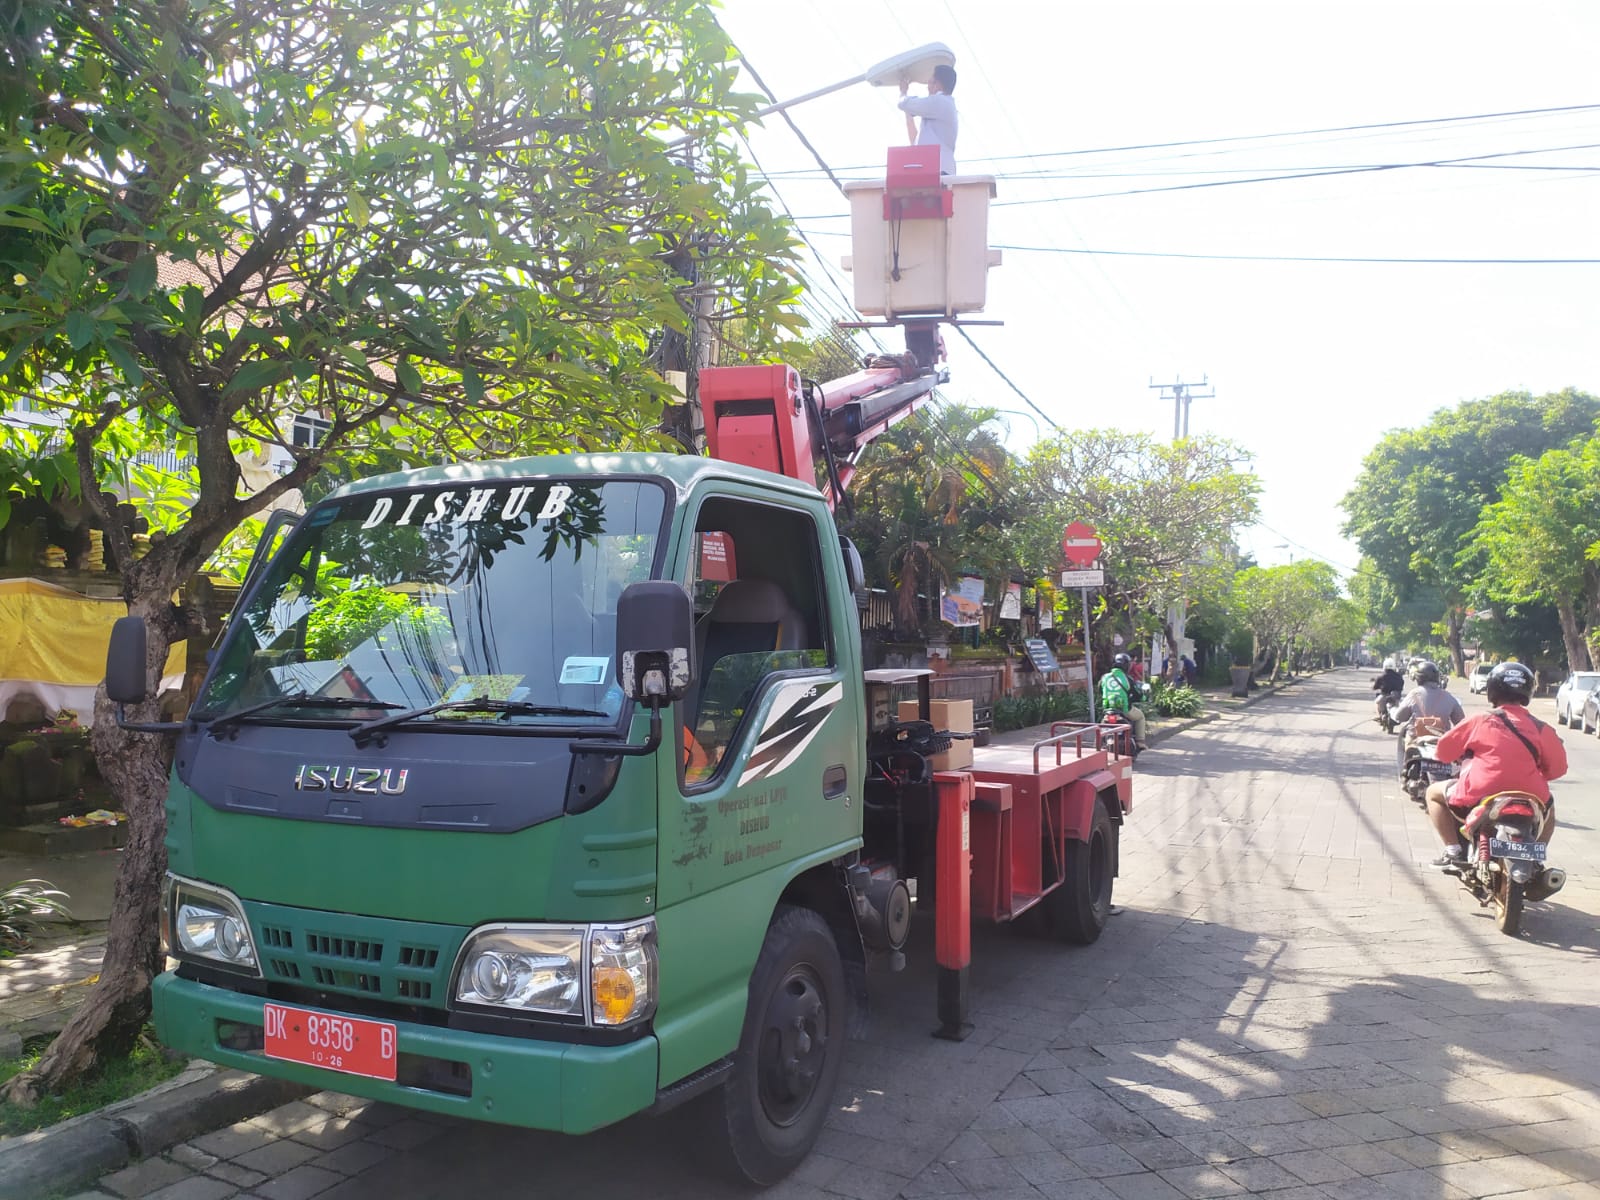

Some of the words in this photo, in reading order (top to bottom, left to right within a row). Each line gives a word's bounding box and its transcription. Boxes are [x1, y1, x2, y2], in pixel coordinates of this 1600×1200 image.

[361, 485, 573, 530] DISHUB
[294, 764, 408, 795] ISUZU
[740, 815, 770, 836] DISHUB
[266, 1007, 287, 1040] DK
[308, 1015, 353, 1052] 8358
[381, 1027, 393, 1059] B
